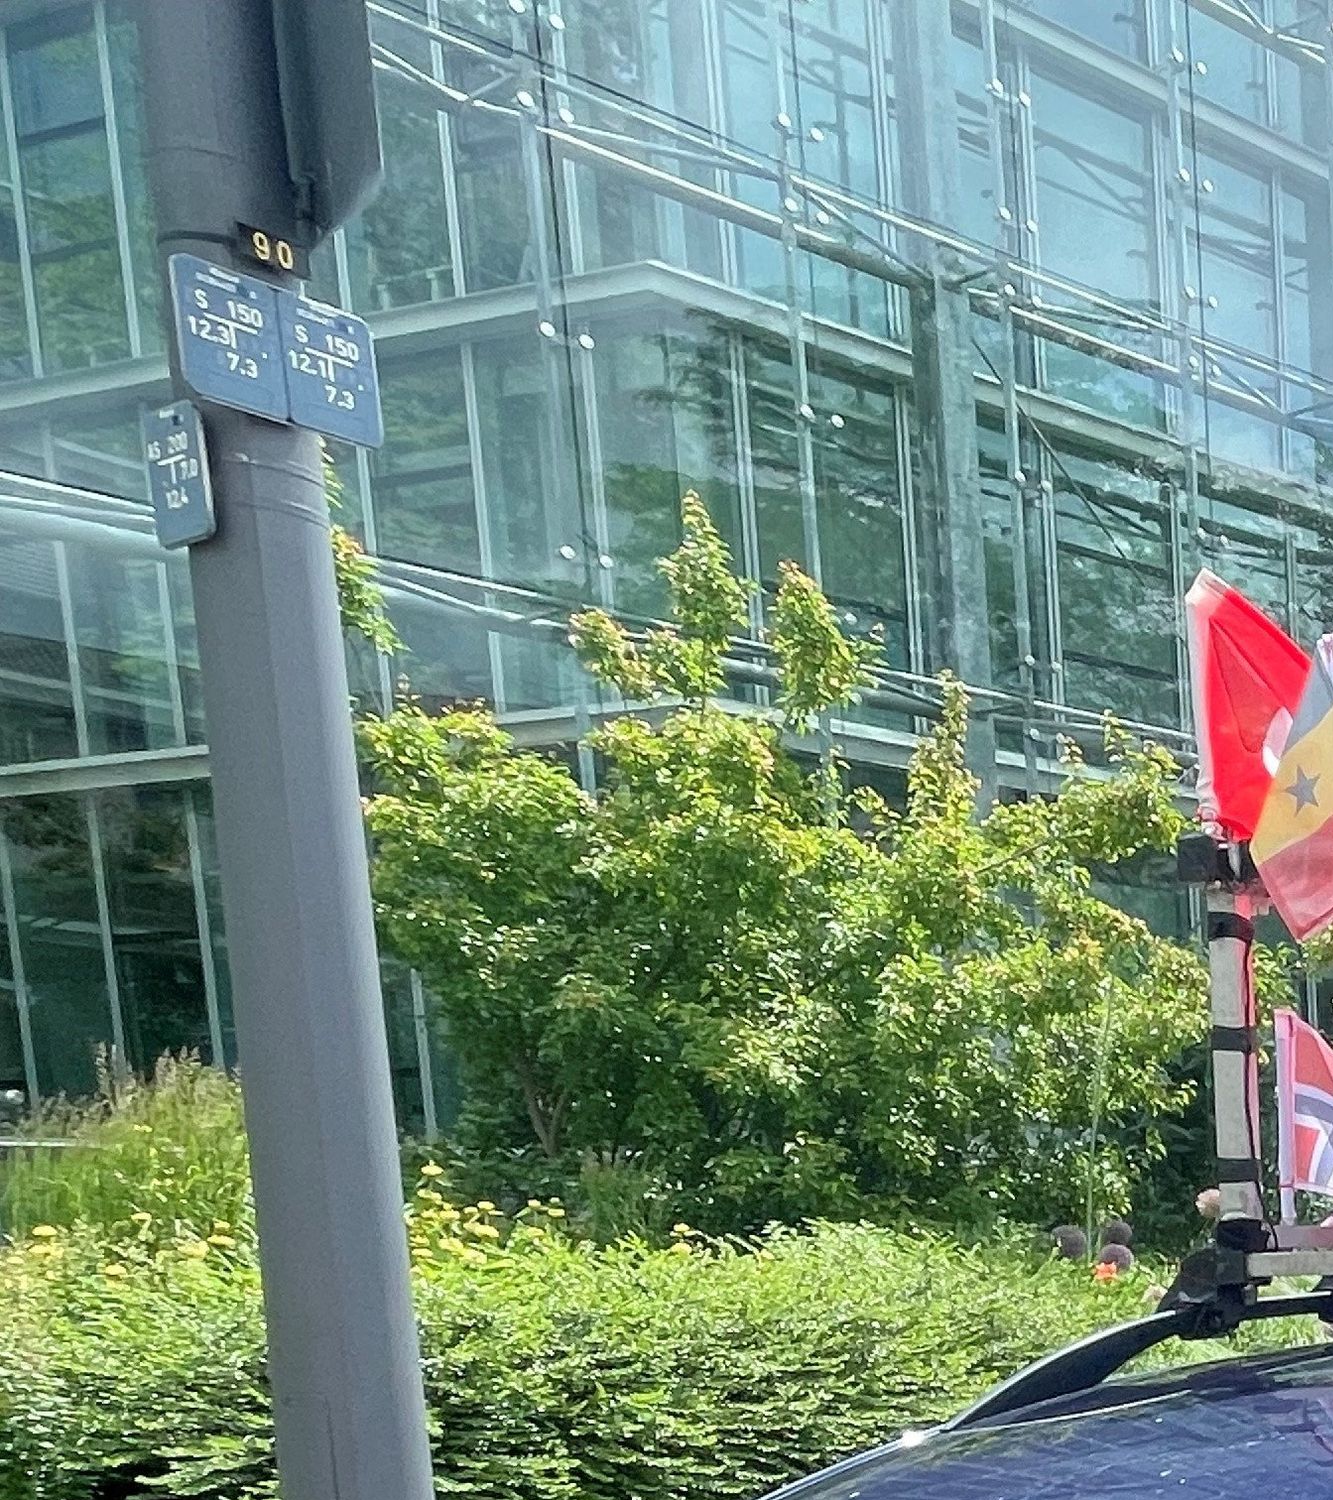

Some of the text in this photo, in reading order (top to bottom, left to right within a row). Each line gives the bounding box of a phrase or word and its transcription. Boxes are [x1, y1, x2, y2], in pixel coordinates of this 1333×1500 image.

[251, 230, 295, 271] 90
[194, 288, 264, 329] S 150
[187, 314, 231, 347] 12.3
[294, 323, 360, 362] S 150
[226, 351, 258, 379] 7.3
[324, 385, 356, 411] 7.3
